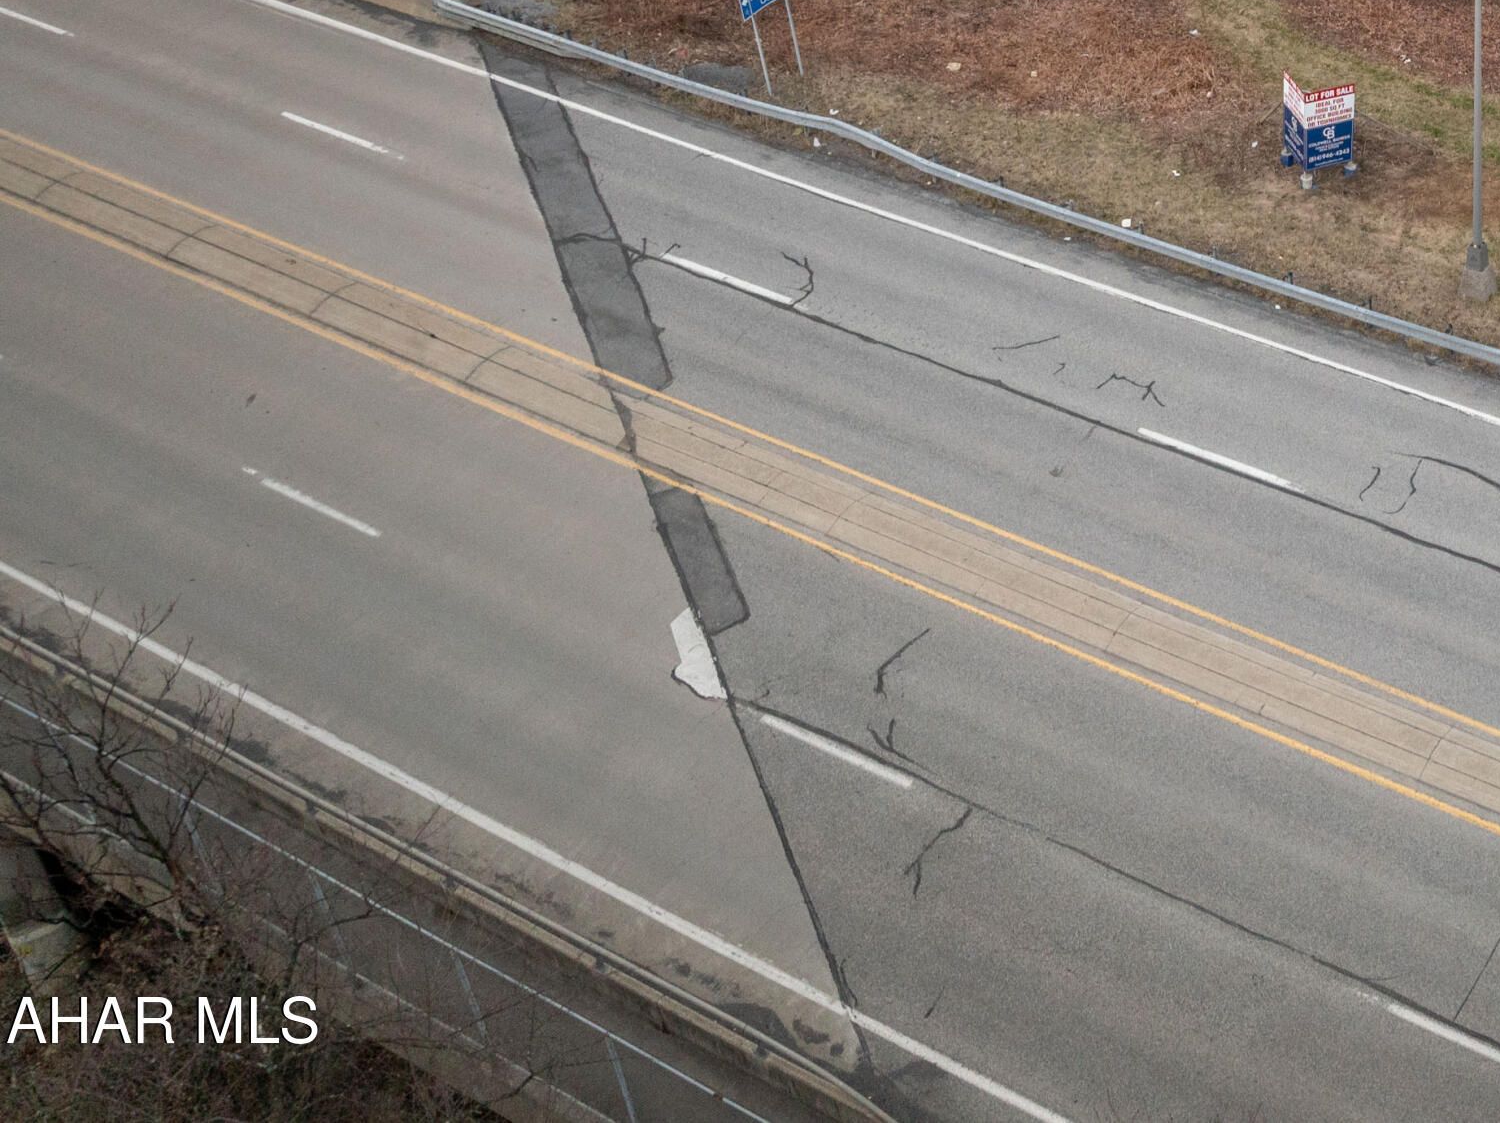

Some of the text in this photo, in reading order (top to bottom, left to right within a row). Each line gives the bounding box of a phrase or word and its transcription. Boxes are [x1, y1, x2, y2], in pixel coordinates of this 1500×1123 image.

[1306, 85, 1354, 102] LOT FOR SALE
[1332, 97, 1344, 105] FOR
[1306, 113, 1326, 122] OFFICE
